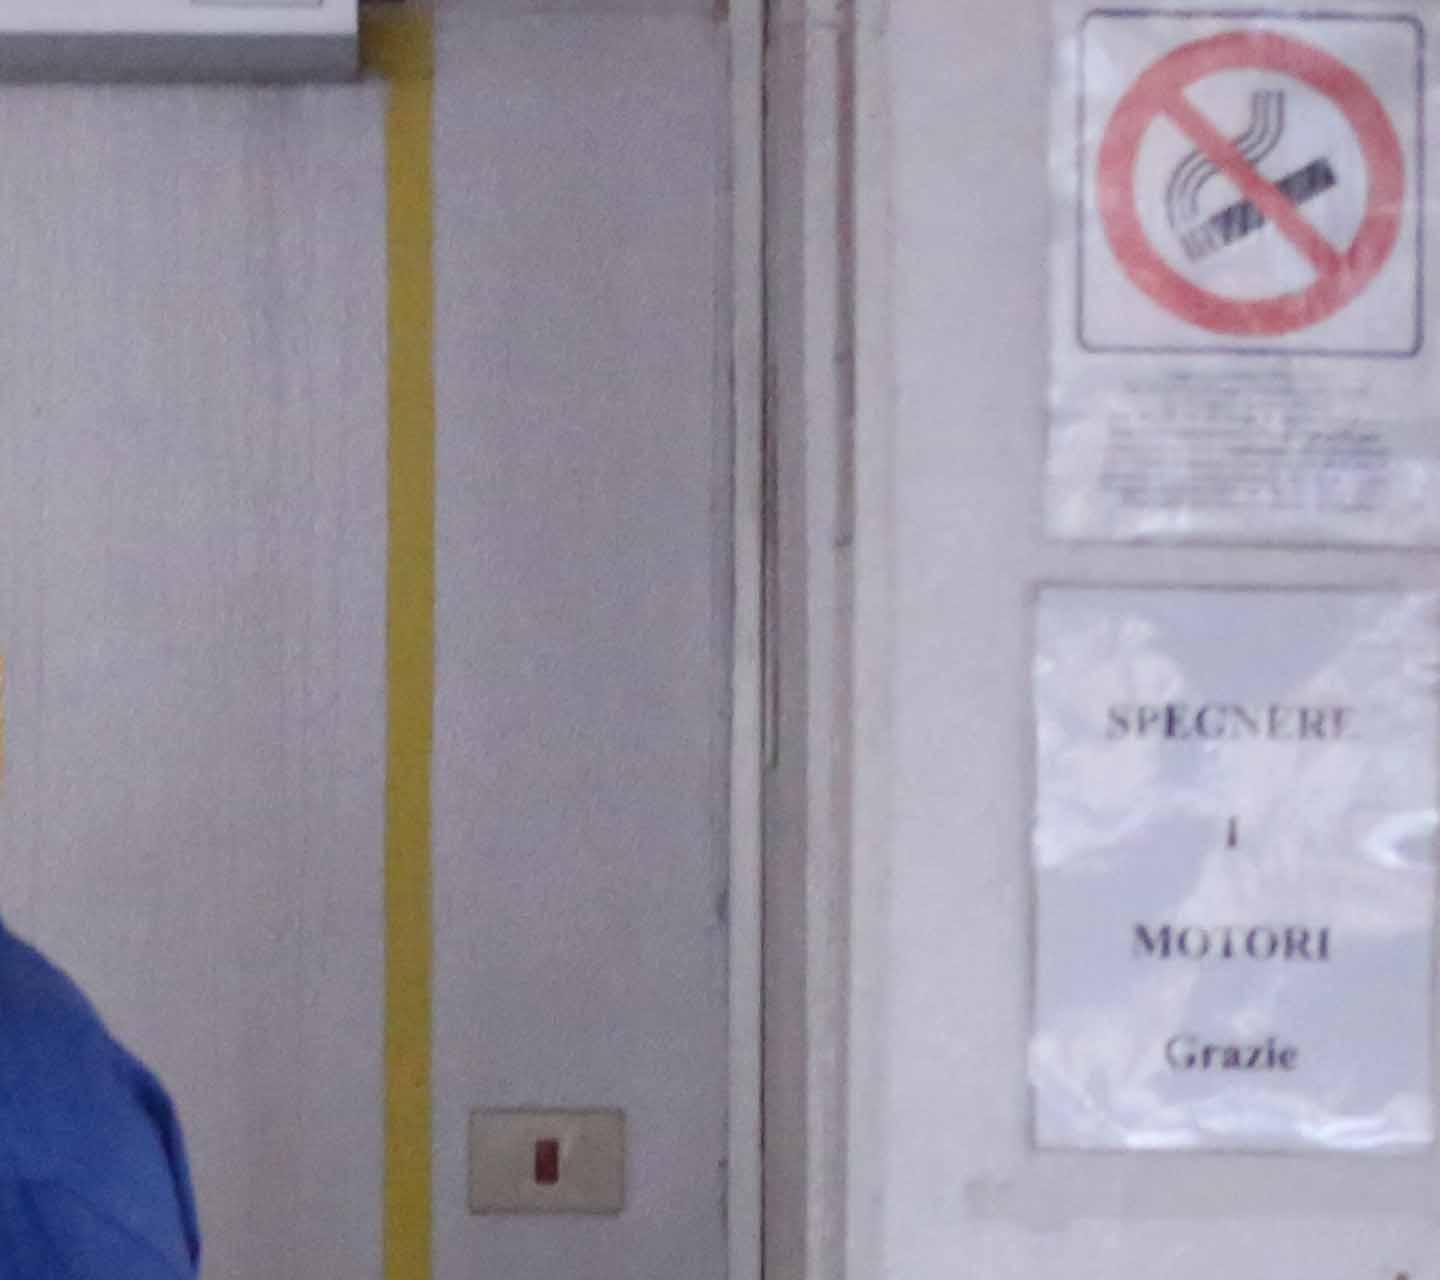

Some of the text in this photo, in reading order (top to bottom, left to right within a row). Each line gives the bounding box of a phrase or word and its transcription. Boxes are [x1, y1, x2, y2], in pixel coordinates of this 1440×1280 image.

[1105, 702, 1362, 741] SPEGNERE
[1132, 923, 1333, 963] MOTORI
[1164, 1034, 1300, 1074] Grazie
